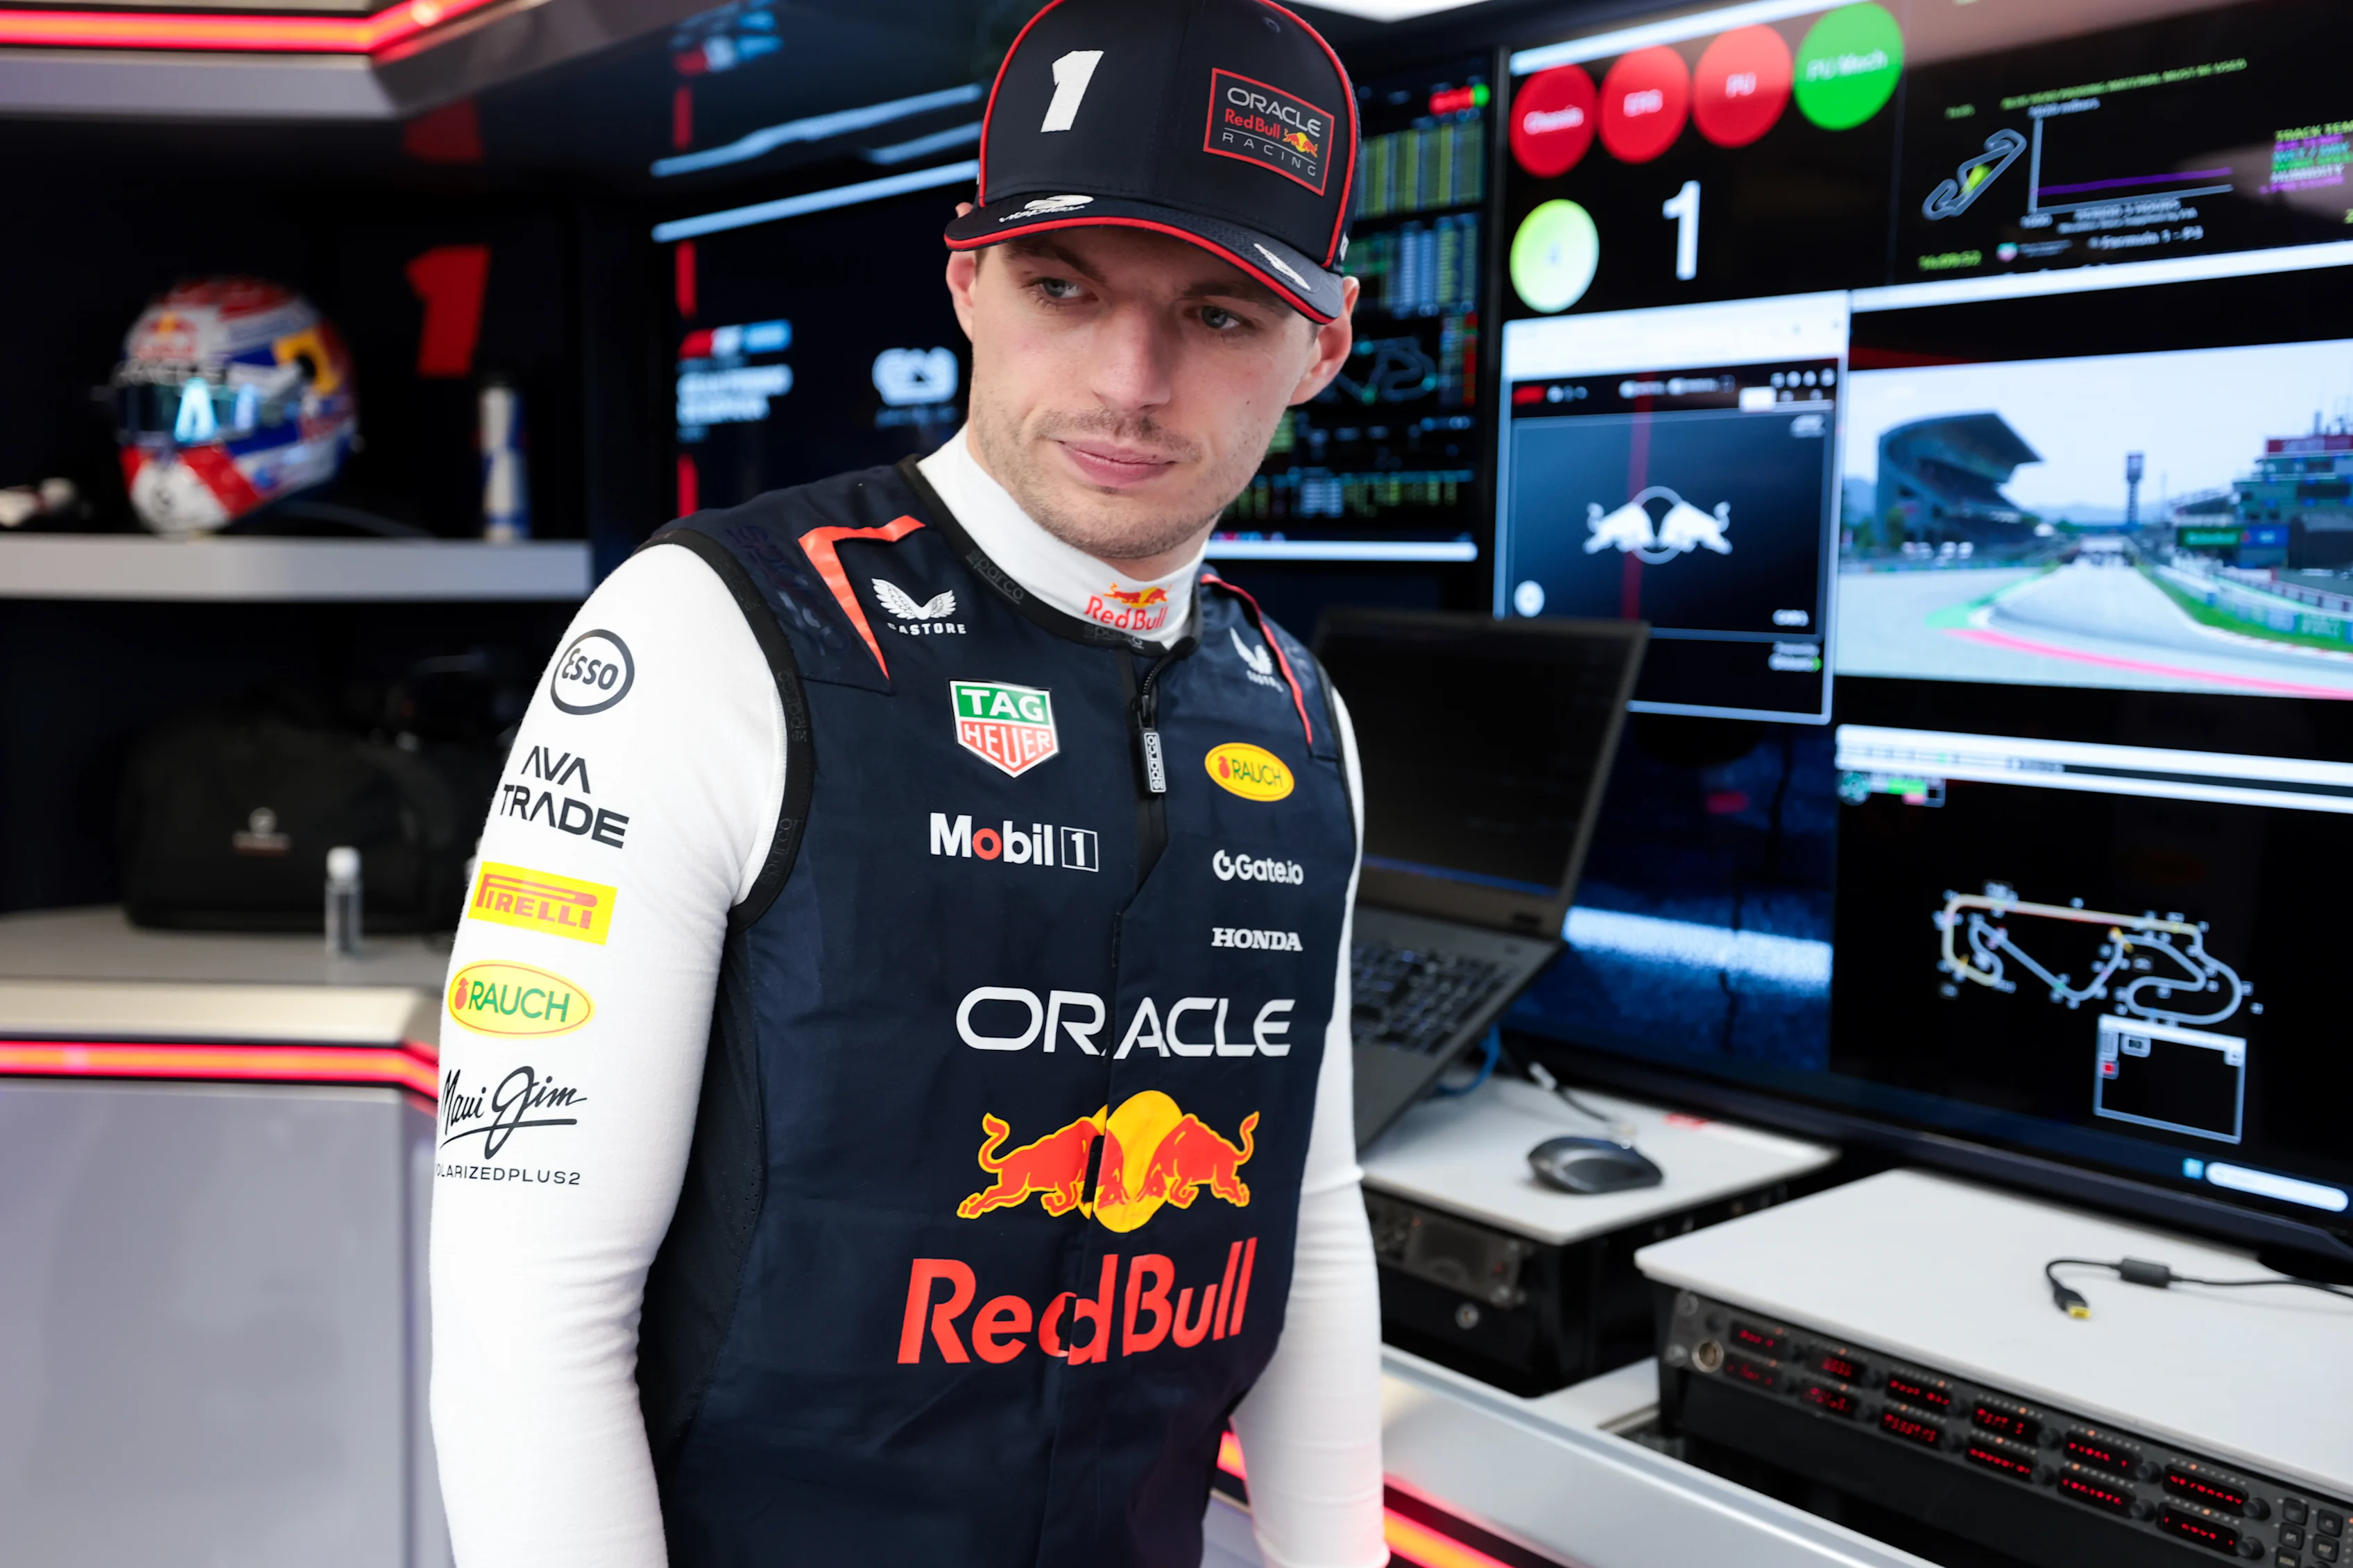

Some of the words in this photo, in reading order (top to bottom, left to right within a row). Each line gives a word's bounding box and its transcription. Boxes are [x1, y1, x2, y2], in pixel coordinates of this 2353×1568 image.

[1041, 50, 1104, 132] 1
[1227, 87, 1321, 137] ORACLE
[1222, 132, 1317, 177] RACING
[1663, 180, 1701, 280] 1
[404, 245, 490, 377] 1
[961, 689, 1044, 722] TAG
[964, 724, 1051, 768] HEUER
[1231, 758, 1283, 788] RAUCH
[500, 784, 630, 849] TRADE
[930, 812, 1054, 866] Mobil
[475, 873, 598, 929] PIRELLI
[1211, 927, 1303, 951] HONDA
[468, 981, 571, 1022] RAUCH
[956, 986, 1296, 1060] ORACLE
[443, 1069, 487, 1136] Maui
[484, 1066, 588, 1160] Jim
[436, 1164, 581, 1185] OLARIZEDPLUS2
